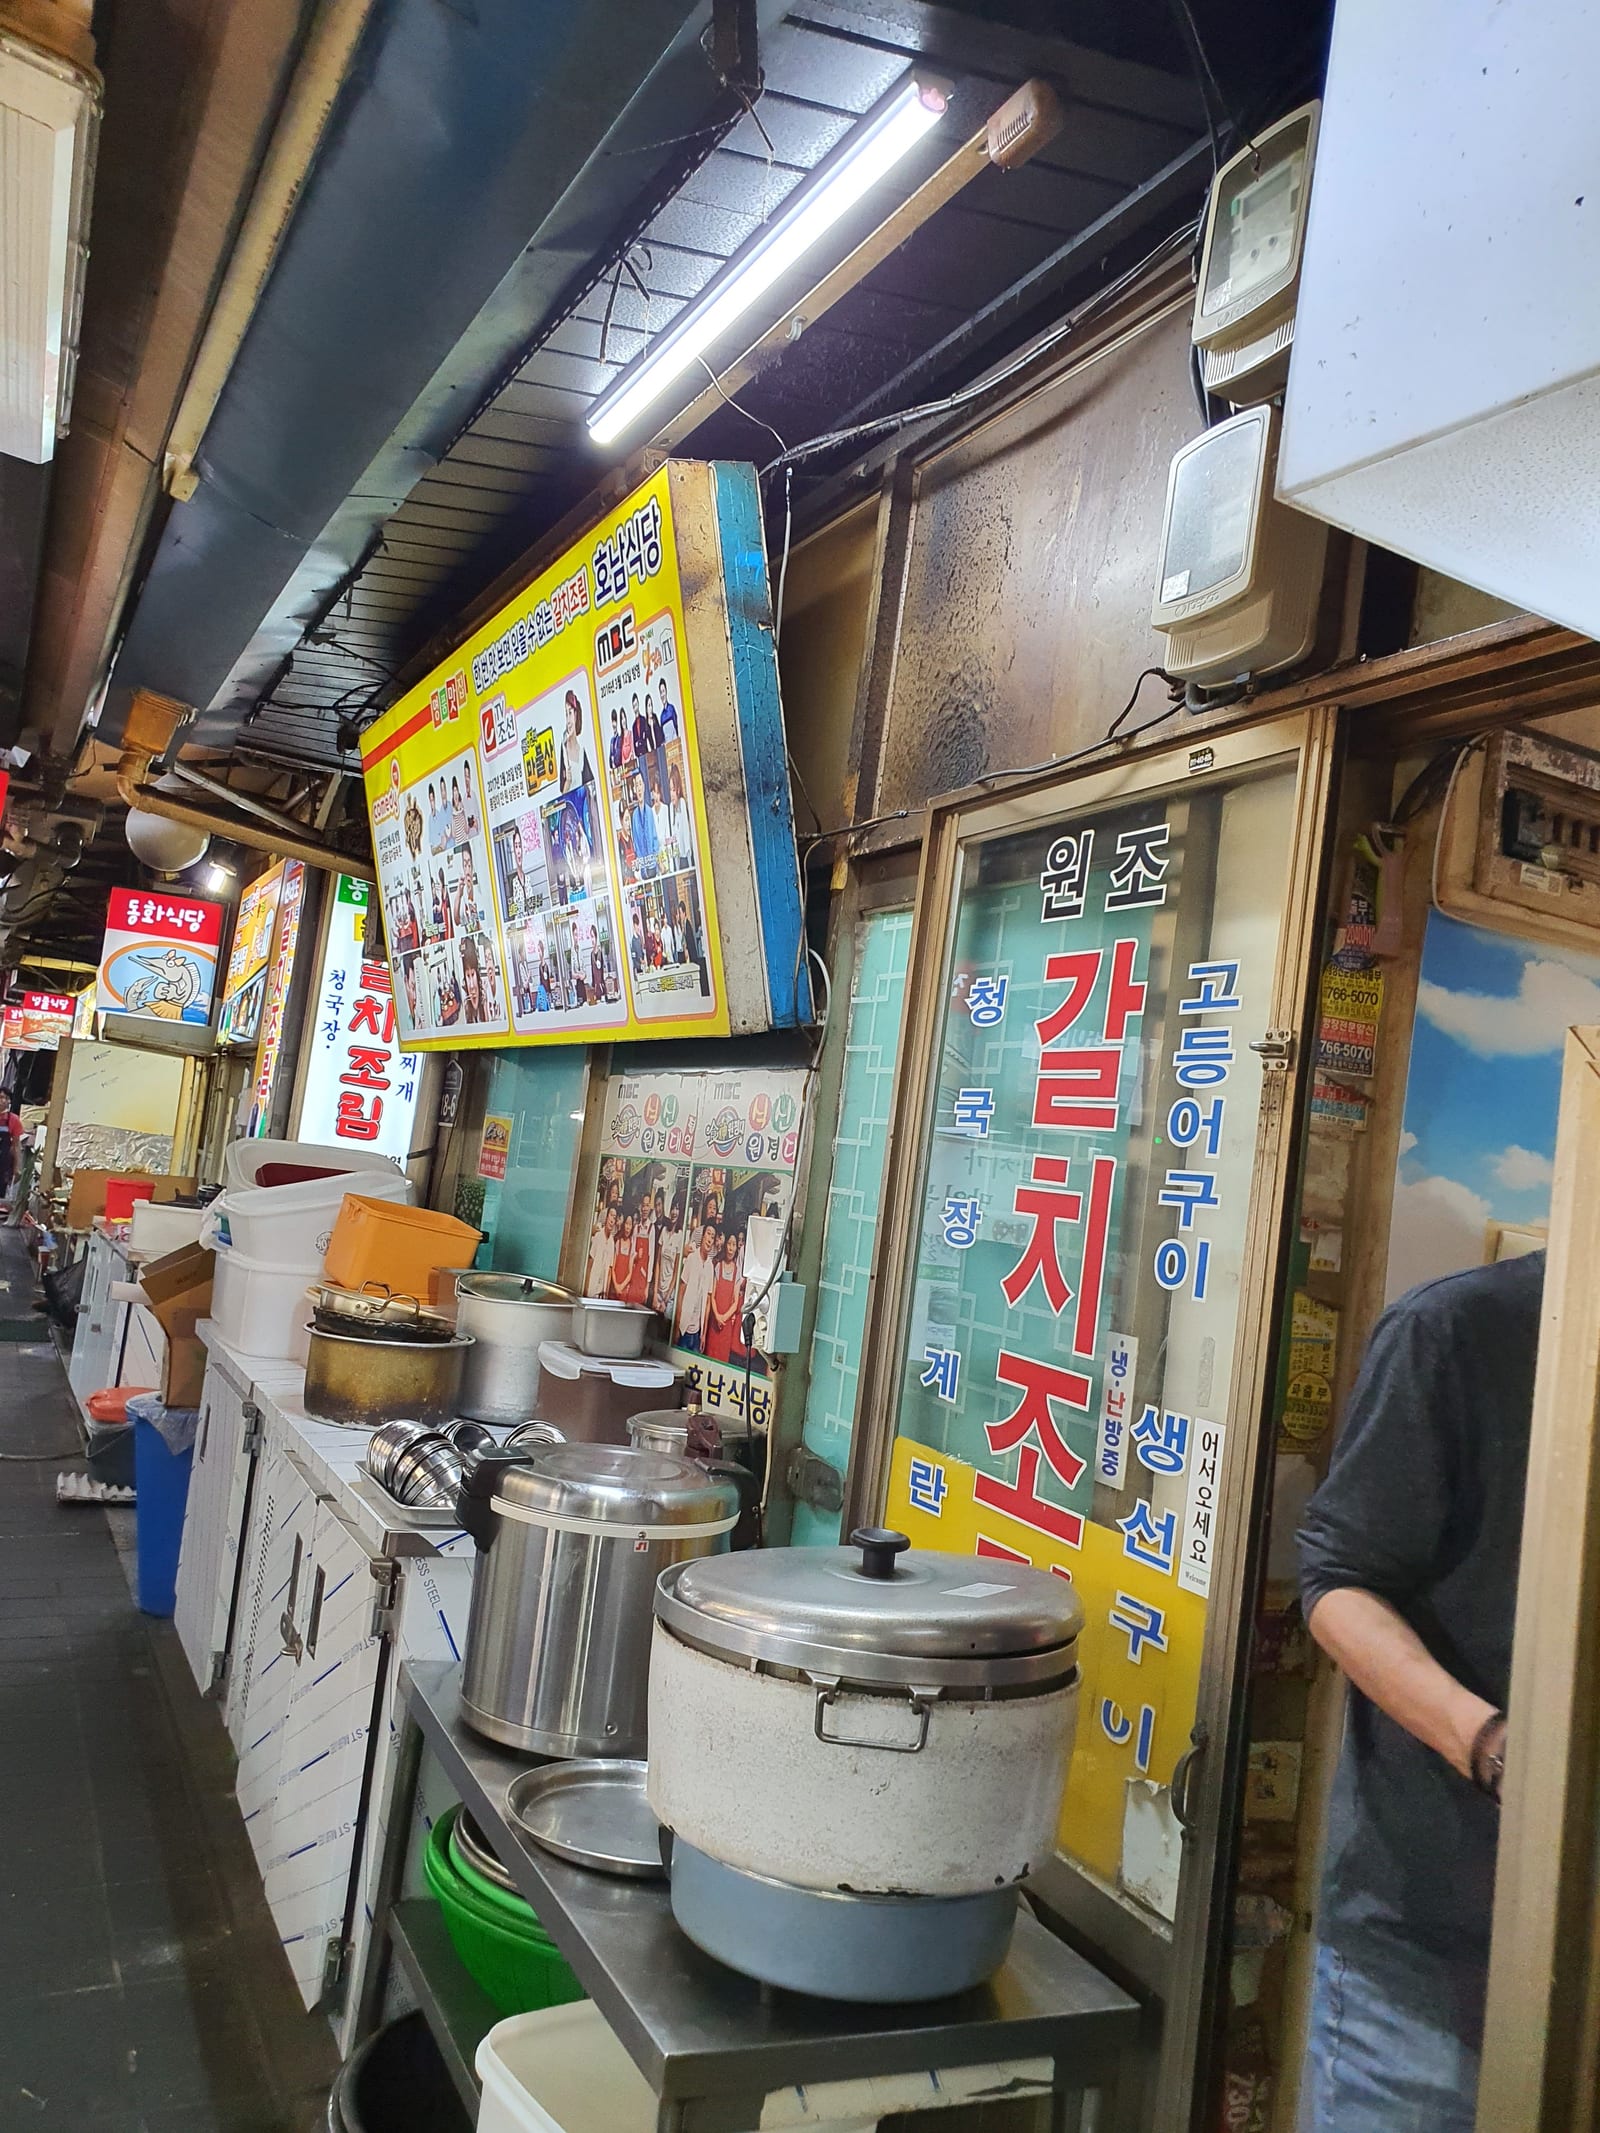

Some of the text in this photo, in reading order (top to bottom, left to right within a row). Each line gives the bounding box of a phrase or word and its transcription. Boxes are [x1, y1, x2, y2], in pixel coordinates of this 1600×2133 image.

[551, 569, 589, 631] 갈치조림
[593, 499, 662, 606] 호남식당
[597, 613, 634, 667] MBC
[494, 700, 505, 721] TV
[497, 714, 516, 745] 조선
[525, 739, 555, 789] 만물상
[1041, 823, 1171, 923] 원조
[126, 899, 206, 934] 동화식당
[260, 907, 293, 1096] 갈치조림
[1327, 986, 1379, 1006] 766-5070
[1320, 1039, 1372, 1061] 766-5070
[940, 976, 1009, 1248] 청국장
[1154, 959, 1242, 1302] 고등어구이
[973, 938, 1147, 1583] 갈치조
[685, 1364, 770, 1425] 호남식당
[1190, 1431, 1219, 1564] 어서오세요
[423, 1578, 441, 1609] STEEL
[1101, 1404, 1191, 1774] 생선구이
